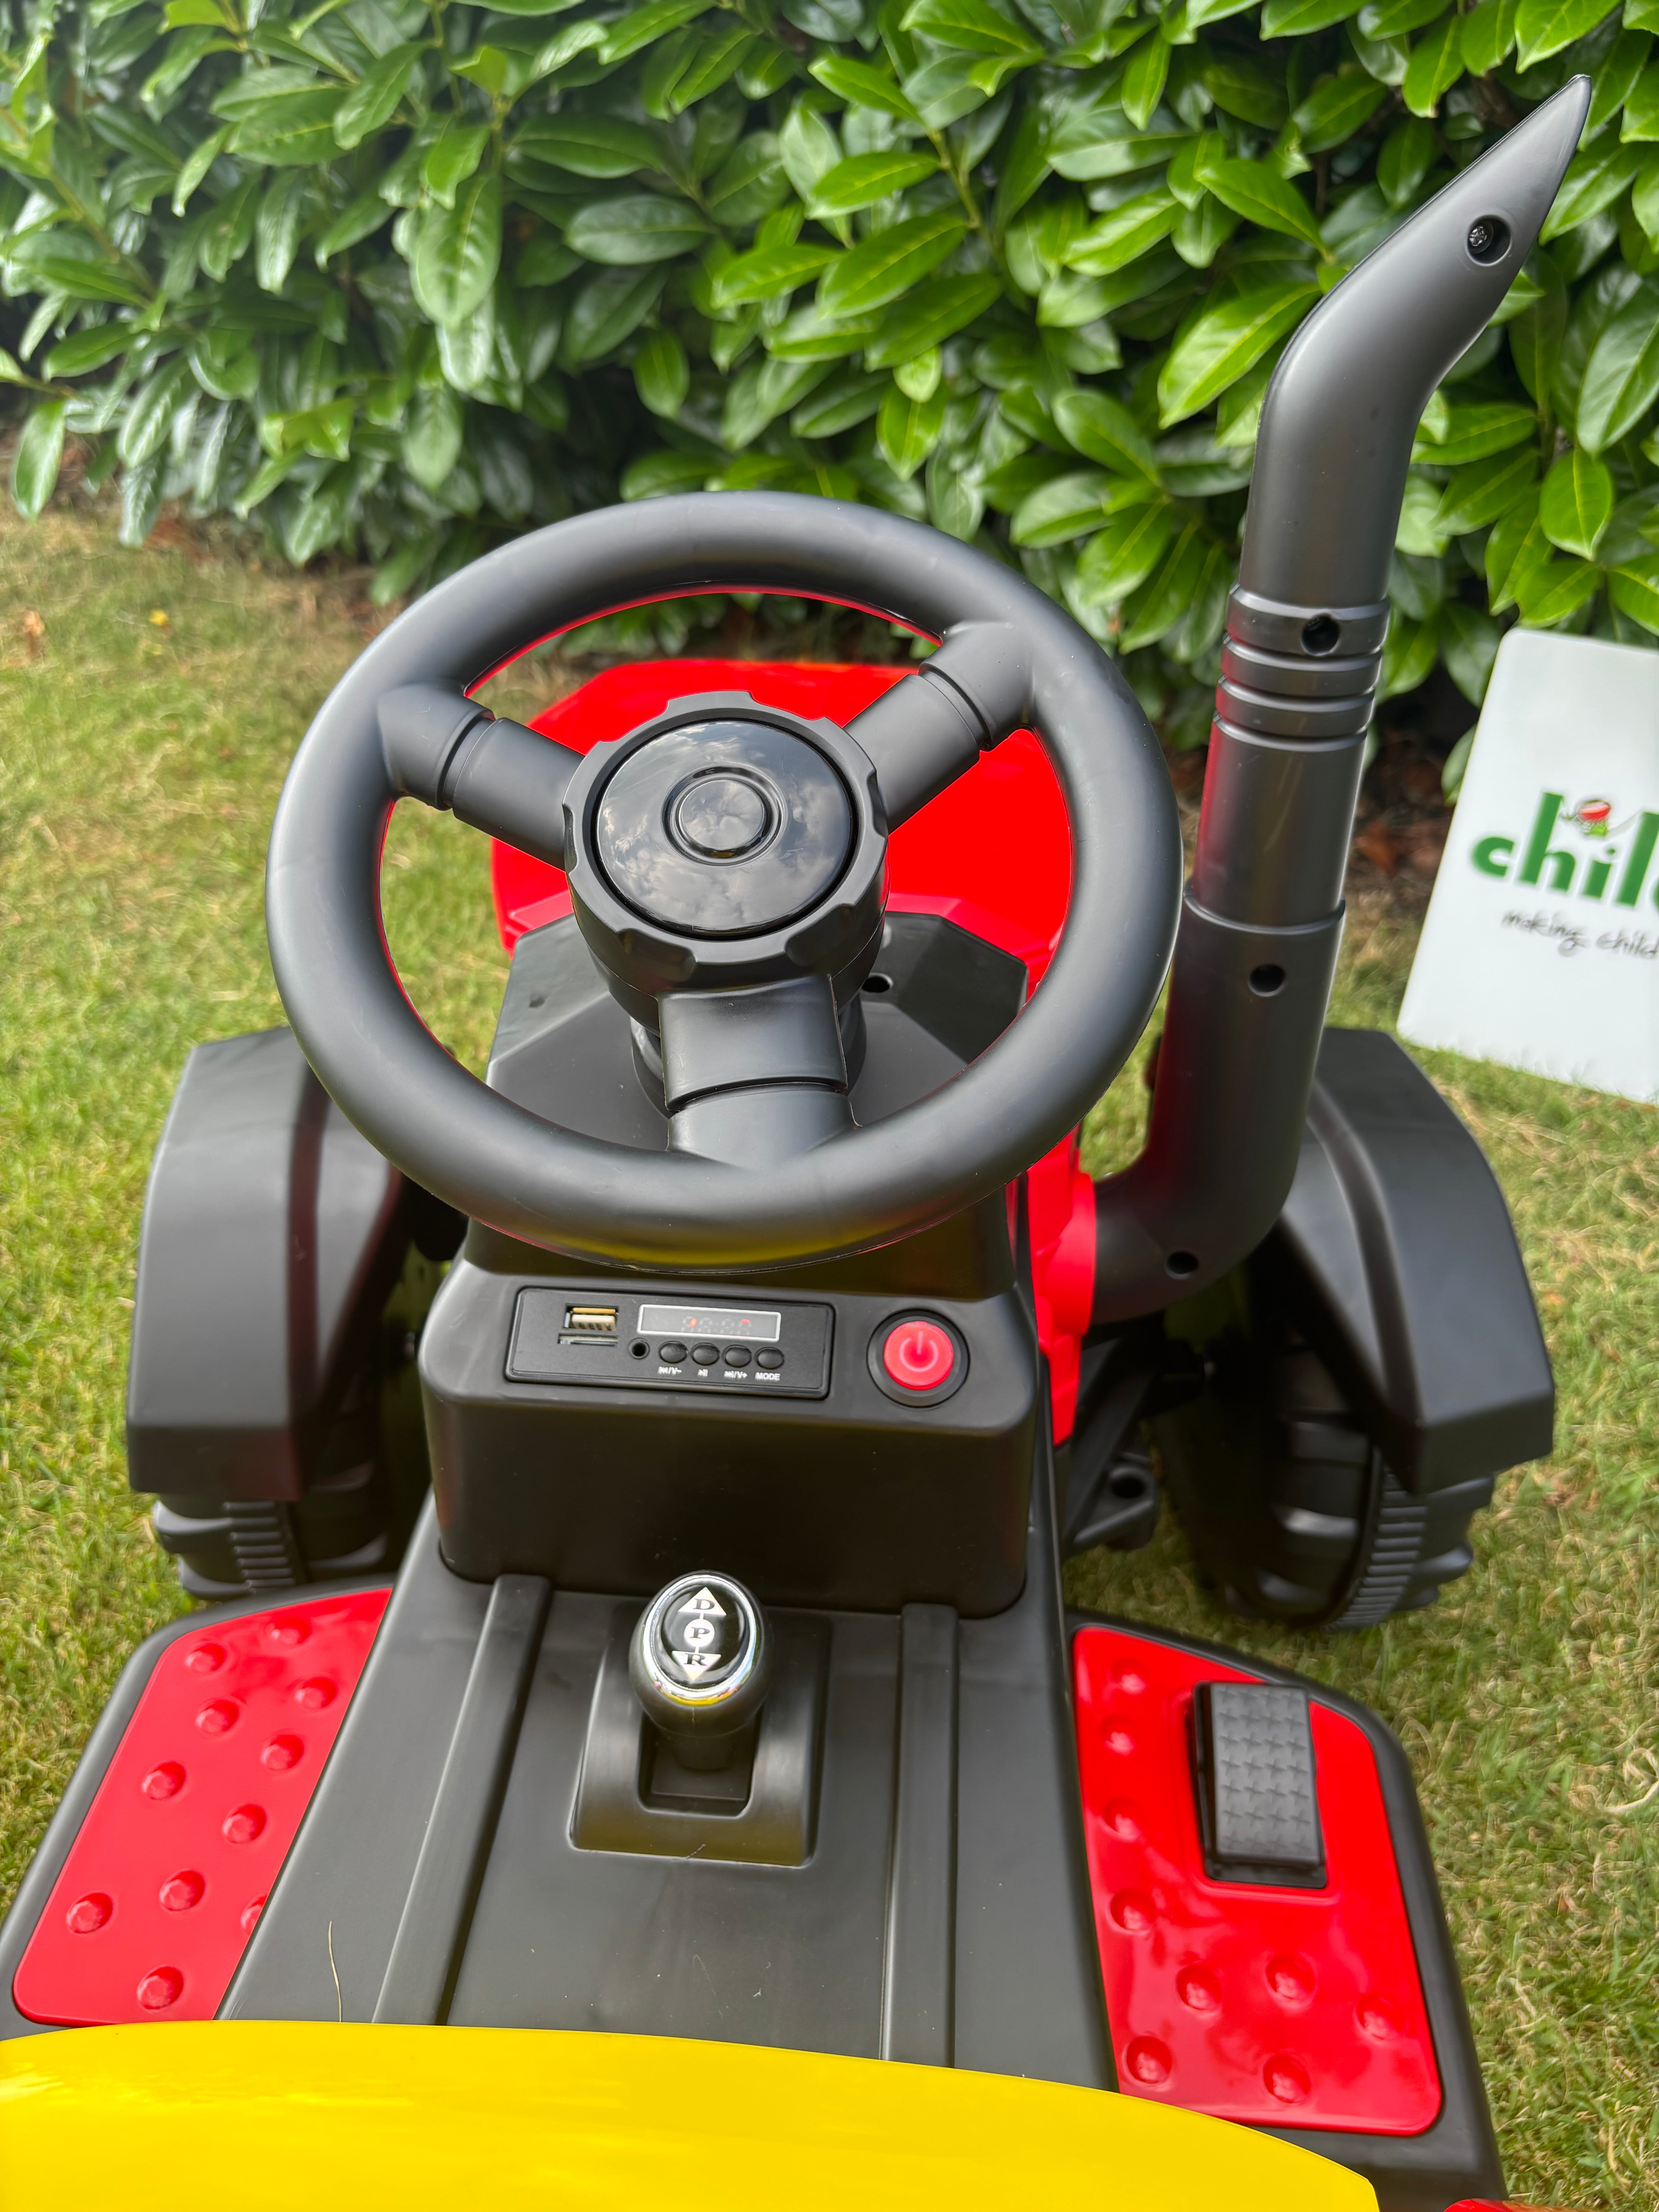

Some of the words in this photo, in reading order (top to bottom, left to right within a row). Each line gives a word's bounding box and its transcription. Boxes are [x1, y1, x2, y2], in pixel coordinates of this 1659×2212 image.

[1472, 792, 1659, 907] chil
[1501, 910, 1587, 957] making
[755, 1372, 781, 1381] MODE
[692, 1598, 715, 1610] D
[689, 1626, 710, 1638] P
[684, 1653, 707, 1666] R
